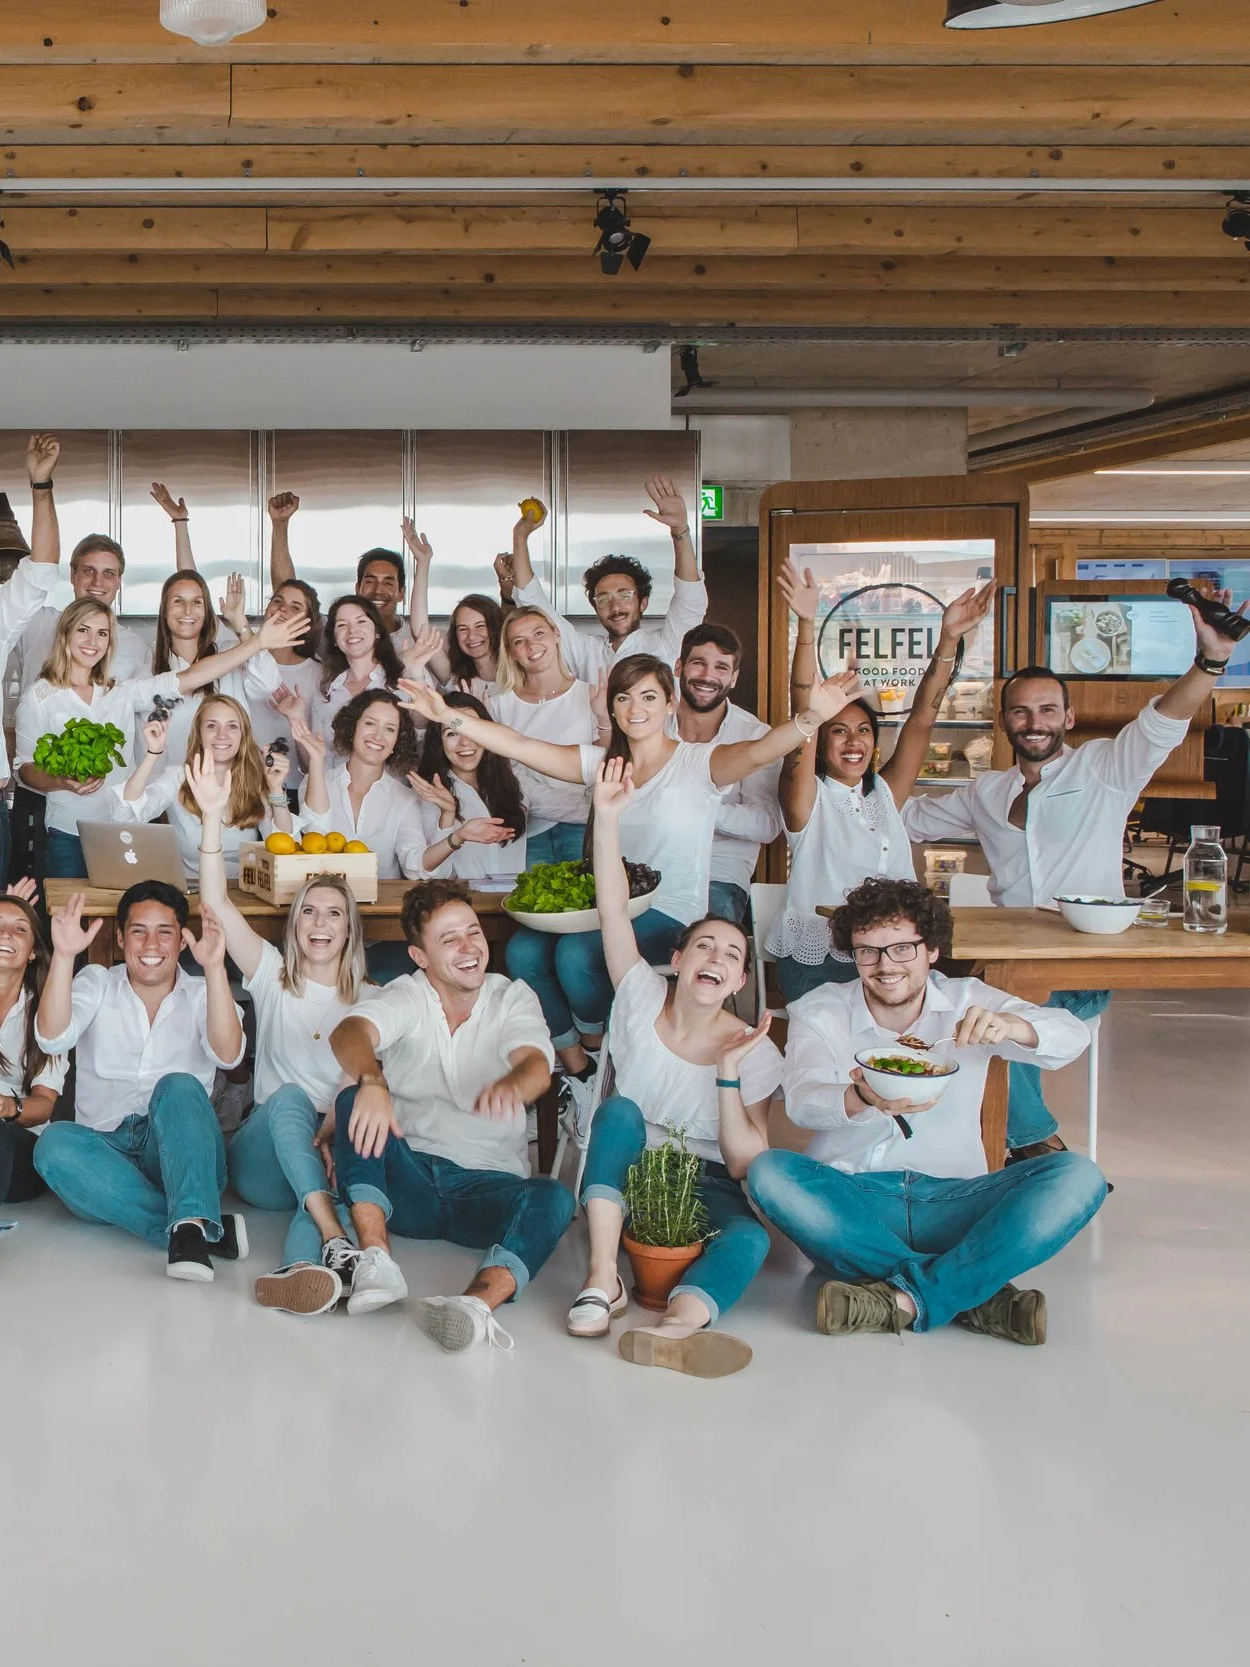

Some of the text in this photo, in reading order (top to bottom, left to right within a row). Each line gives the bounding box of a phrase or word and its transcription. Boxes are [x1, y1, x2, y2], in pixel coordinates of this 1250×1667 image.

[892, 667, 925, 676] FOOD
[863, 679, 916, 687] AT WORK
